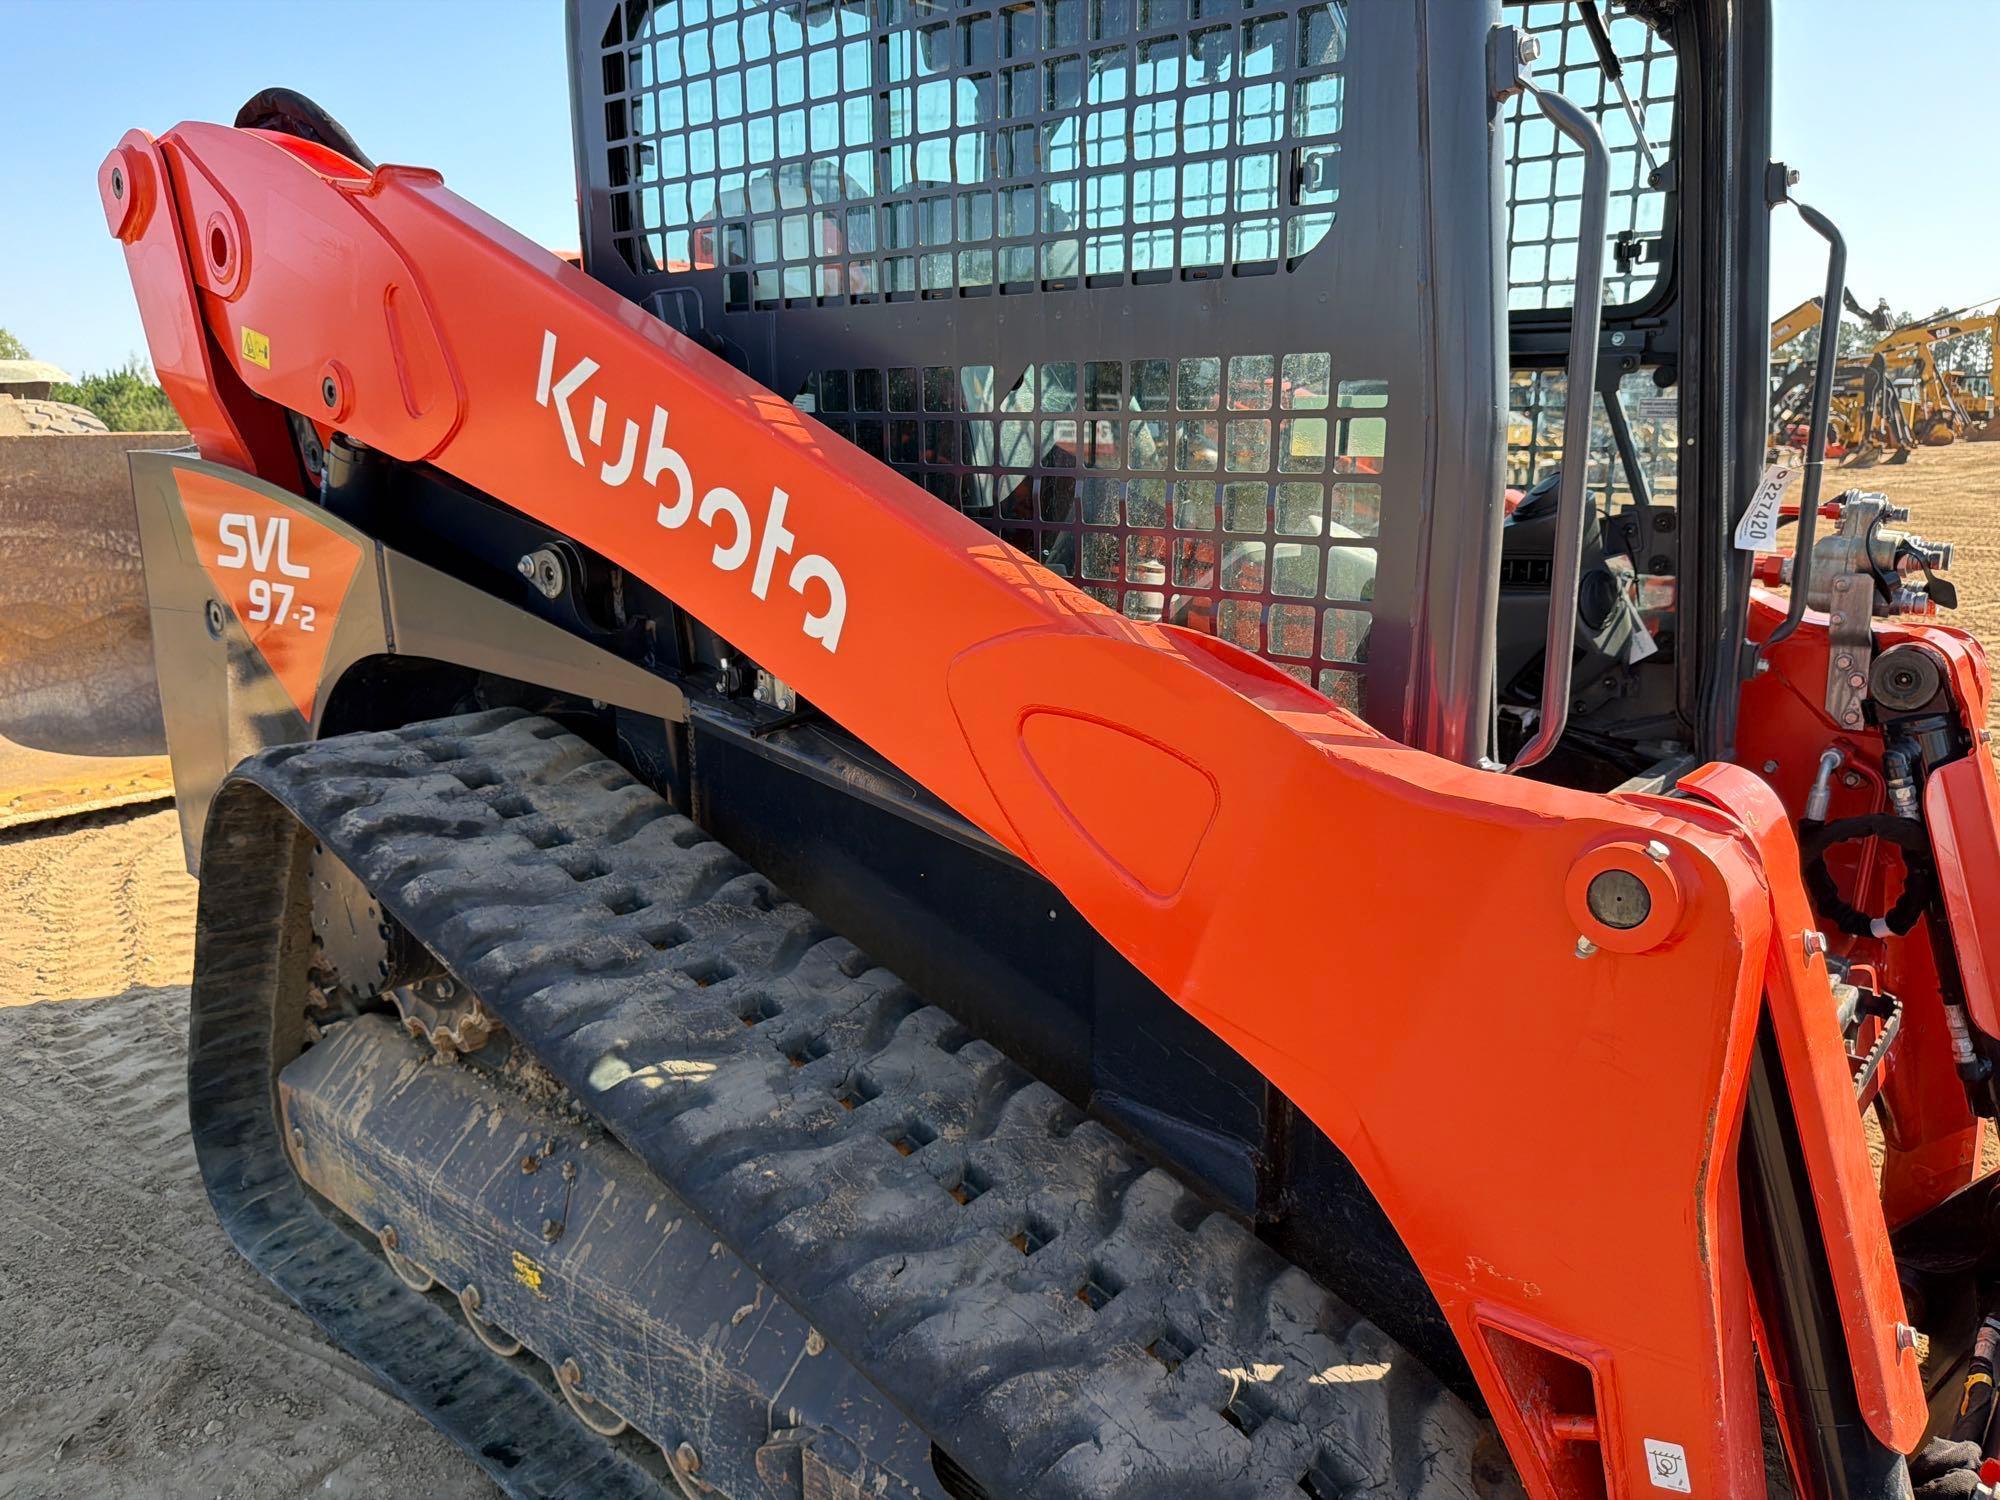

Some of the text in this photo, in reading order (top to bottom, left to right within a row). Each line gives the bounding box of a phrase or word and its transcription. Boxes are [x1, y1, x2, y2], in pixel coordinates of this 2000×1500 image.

[535, 329, 847, 654] Kubota
[1749, 482, 1782, 540] 227420
[217, 513, 310, 579] SVL
[248, 578, 316, 632] 97-2
